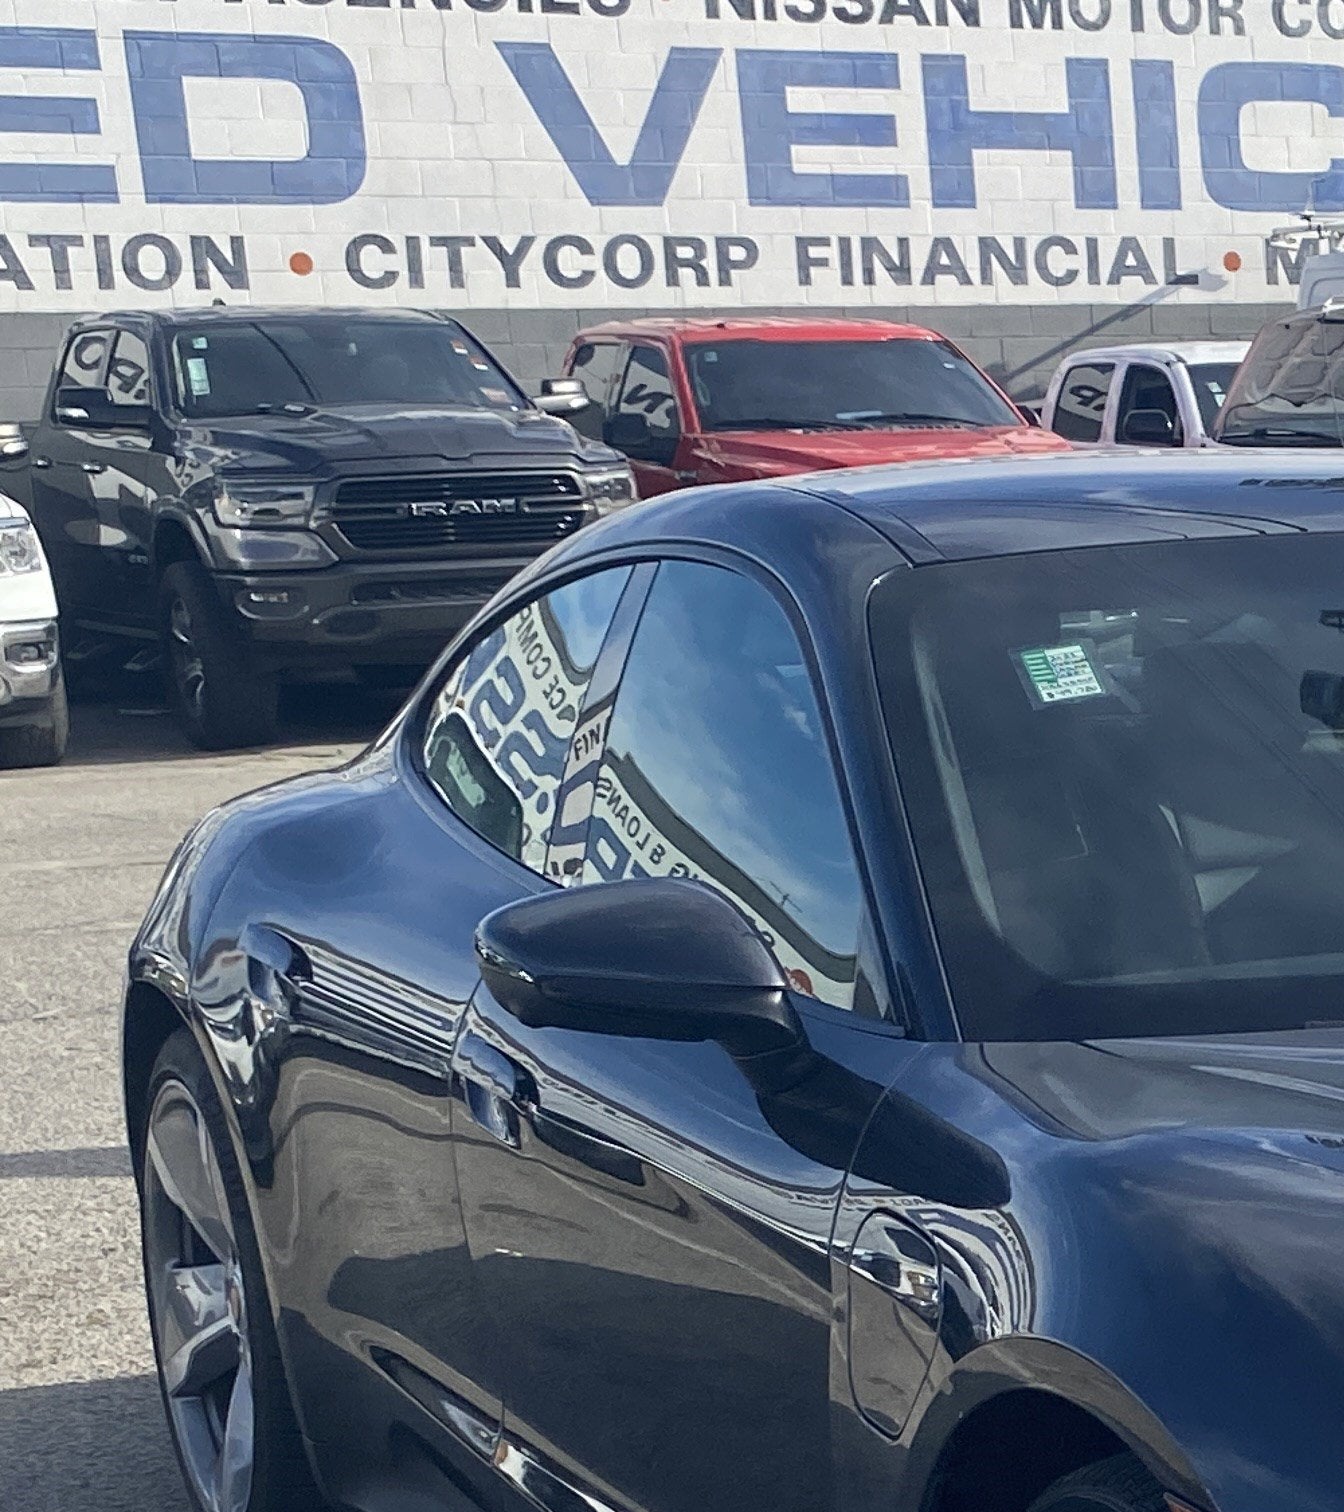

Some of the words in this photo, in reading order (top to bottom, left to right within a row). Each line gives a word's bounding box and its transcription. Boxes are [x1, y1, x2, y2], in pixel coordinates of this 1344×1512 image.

[345, 233, 759, 290] CITYCORP
[796, 235, 1200, 288] FINANCIAL
[410, 498, 517, 517] RAM
